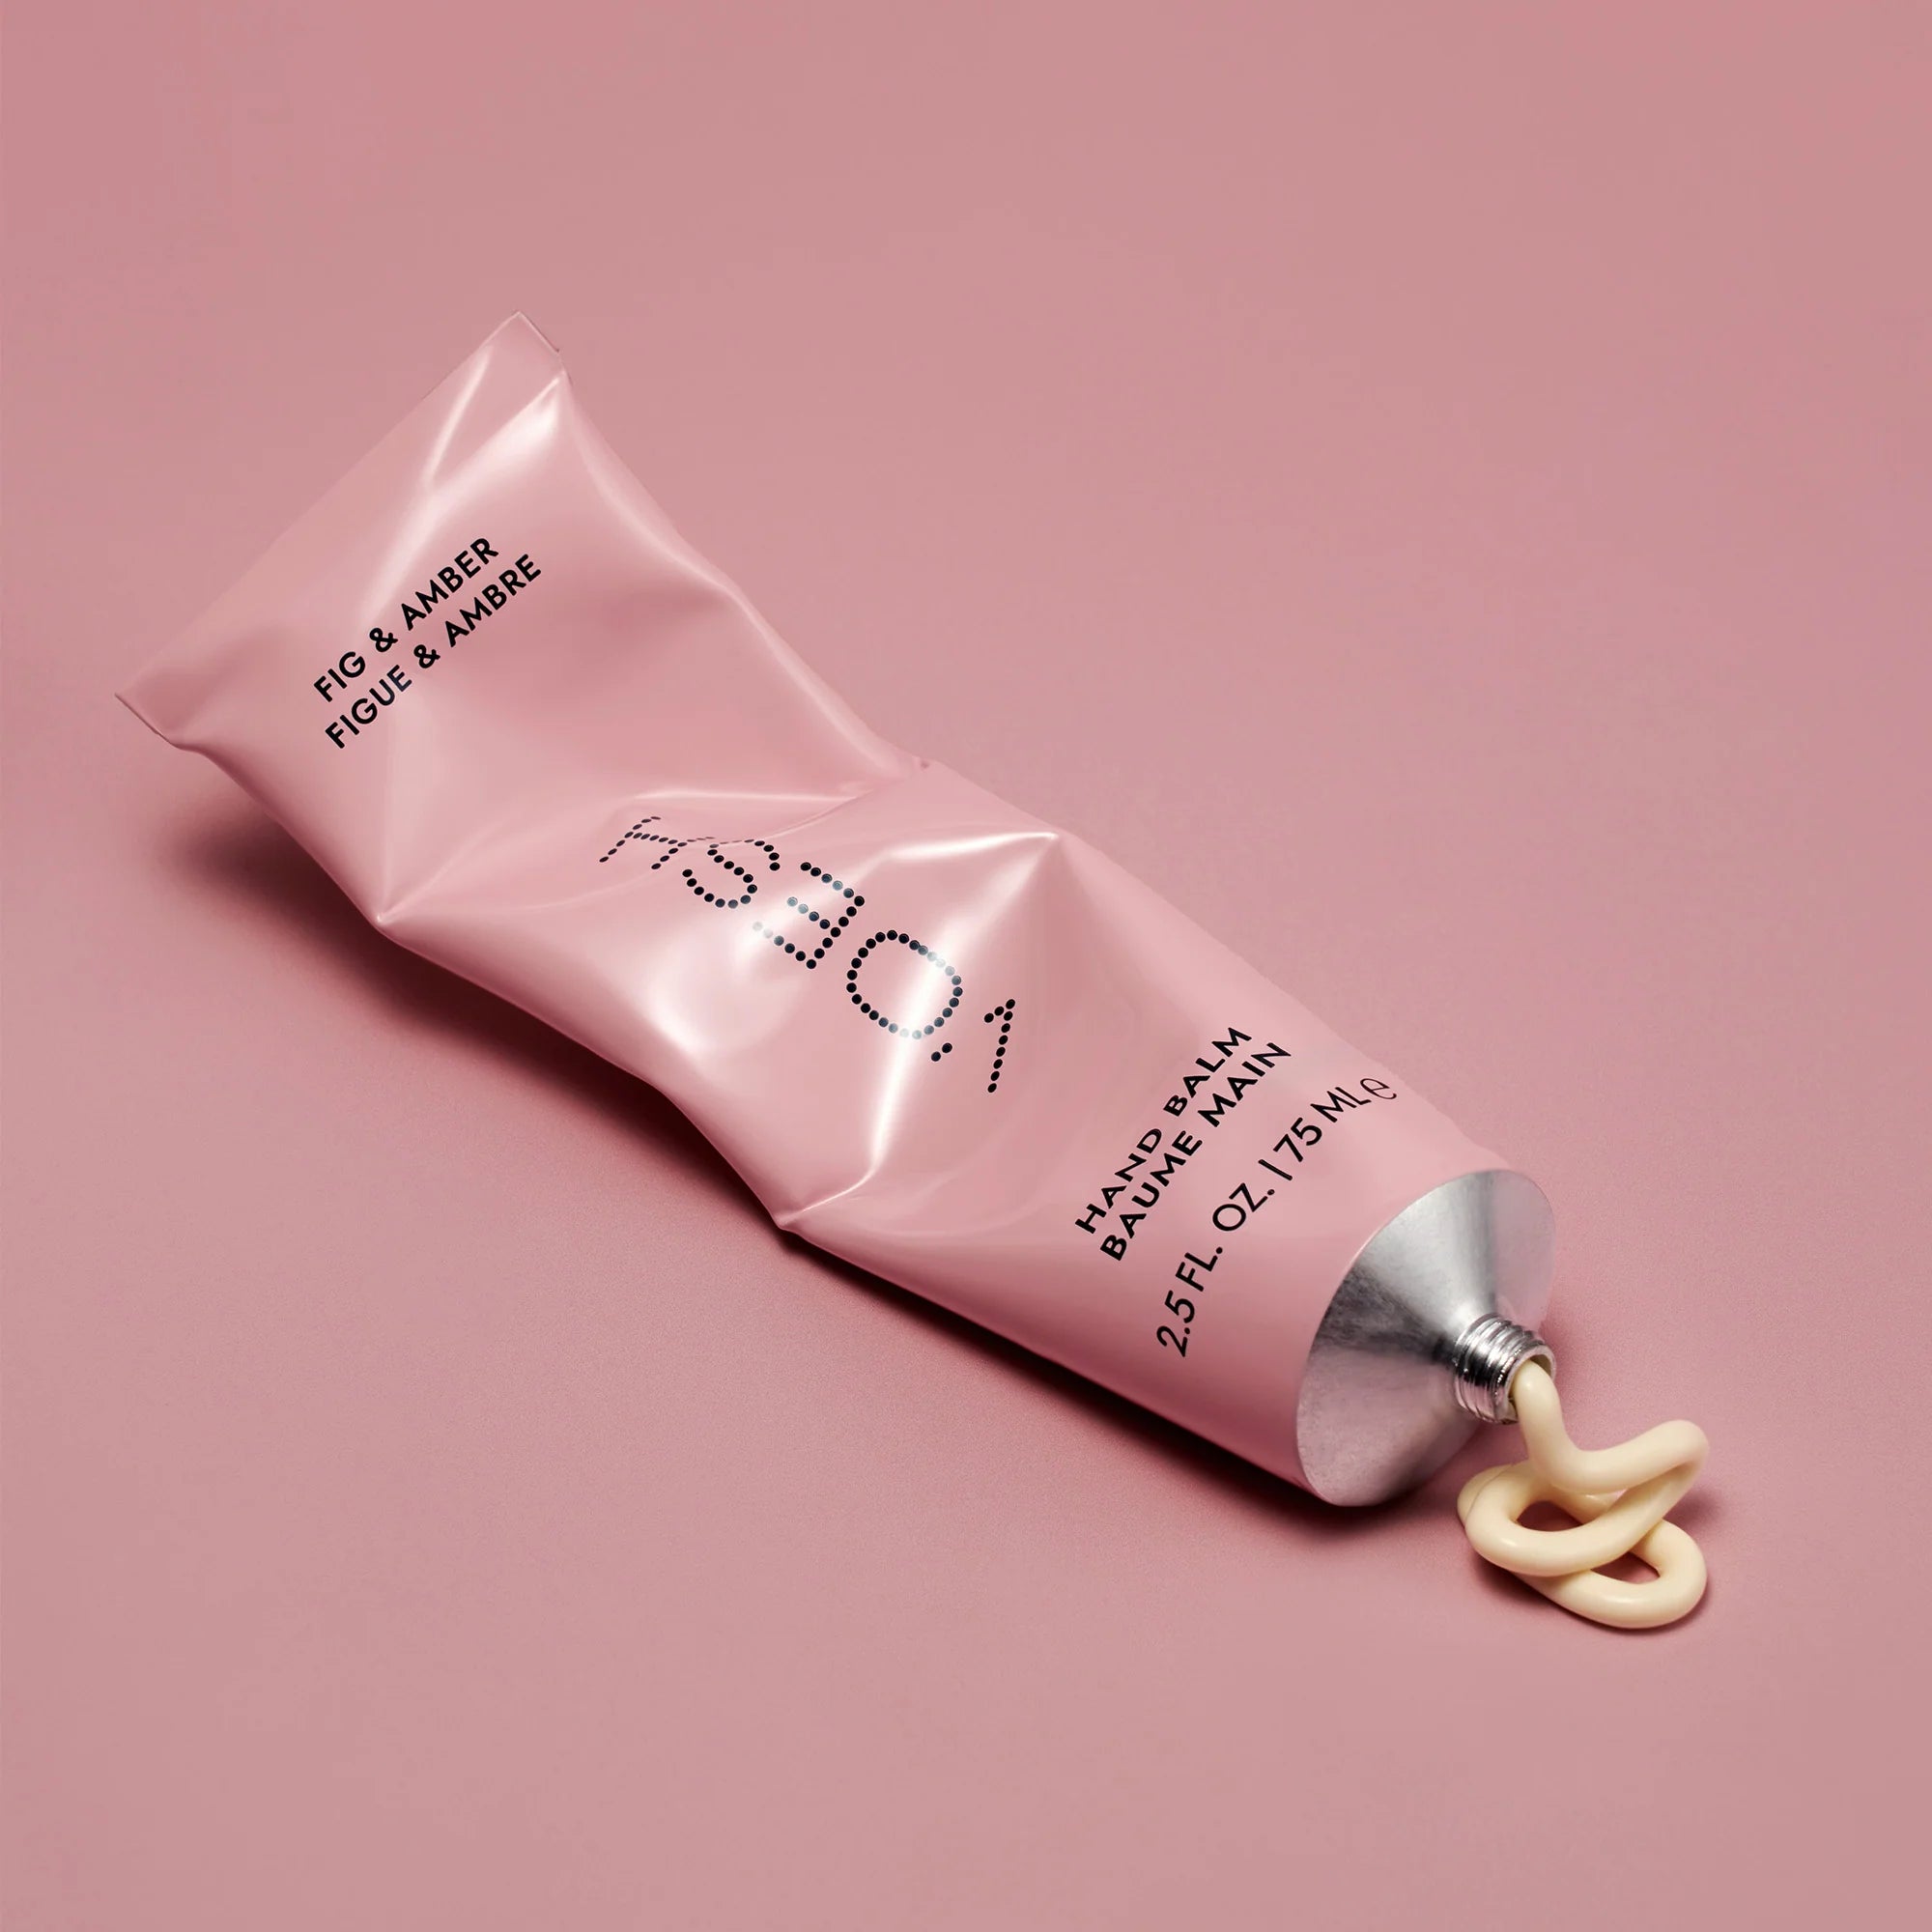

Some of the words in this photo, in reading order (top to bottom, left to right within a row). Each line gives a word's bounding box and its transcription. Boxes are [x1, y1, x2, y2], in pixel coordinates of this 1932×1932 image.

[313, 651, 366, 703] FIG
[369, 627, 399, 653] &
[401, 538, 499, 632] AMBER
[325, 664, 412, 750] FIGUE
[413, 643, 441, 669] &
[444, 554, 542, 648] AMBRE
[1074, 1127, 1162, 1235] HAND
[1162, 1027, 1252, 1117] BALM
[1099, 1130, 1203, 1262] BAUME
[1197, 1042, 1292, 1128] MAIN
[1272, 1117, 1322, 1163] 75
[1211, 1182, 1276, 1232] OZ.
[1155, 1290, 1196, 1358] 2.5
[1175, 1246, 1224, 1293] FL.
